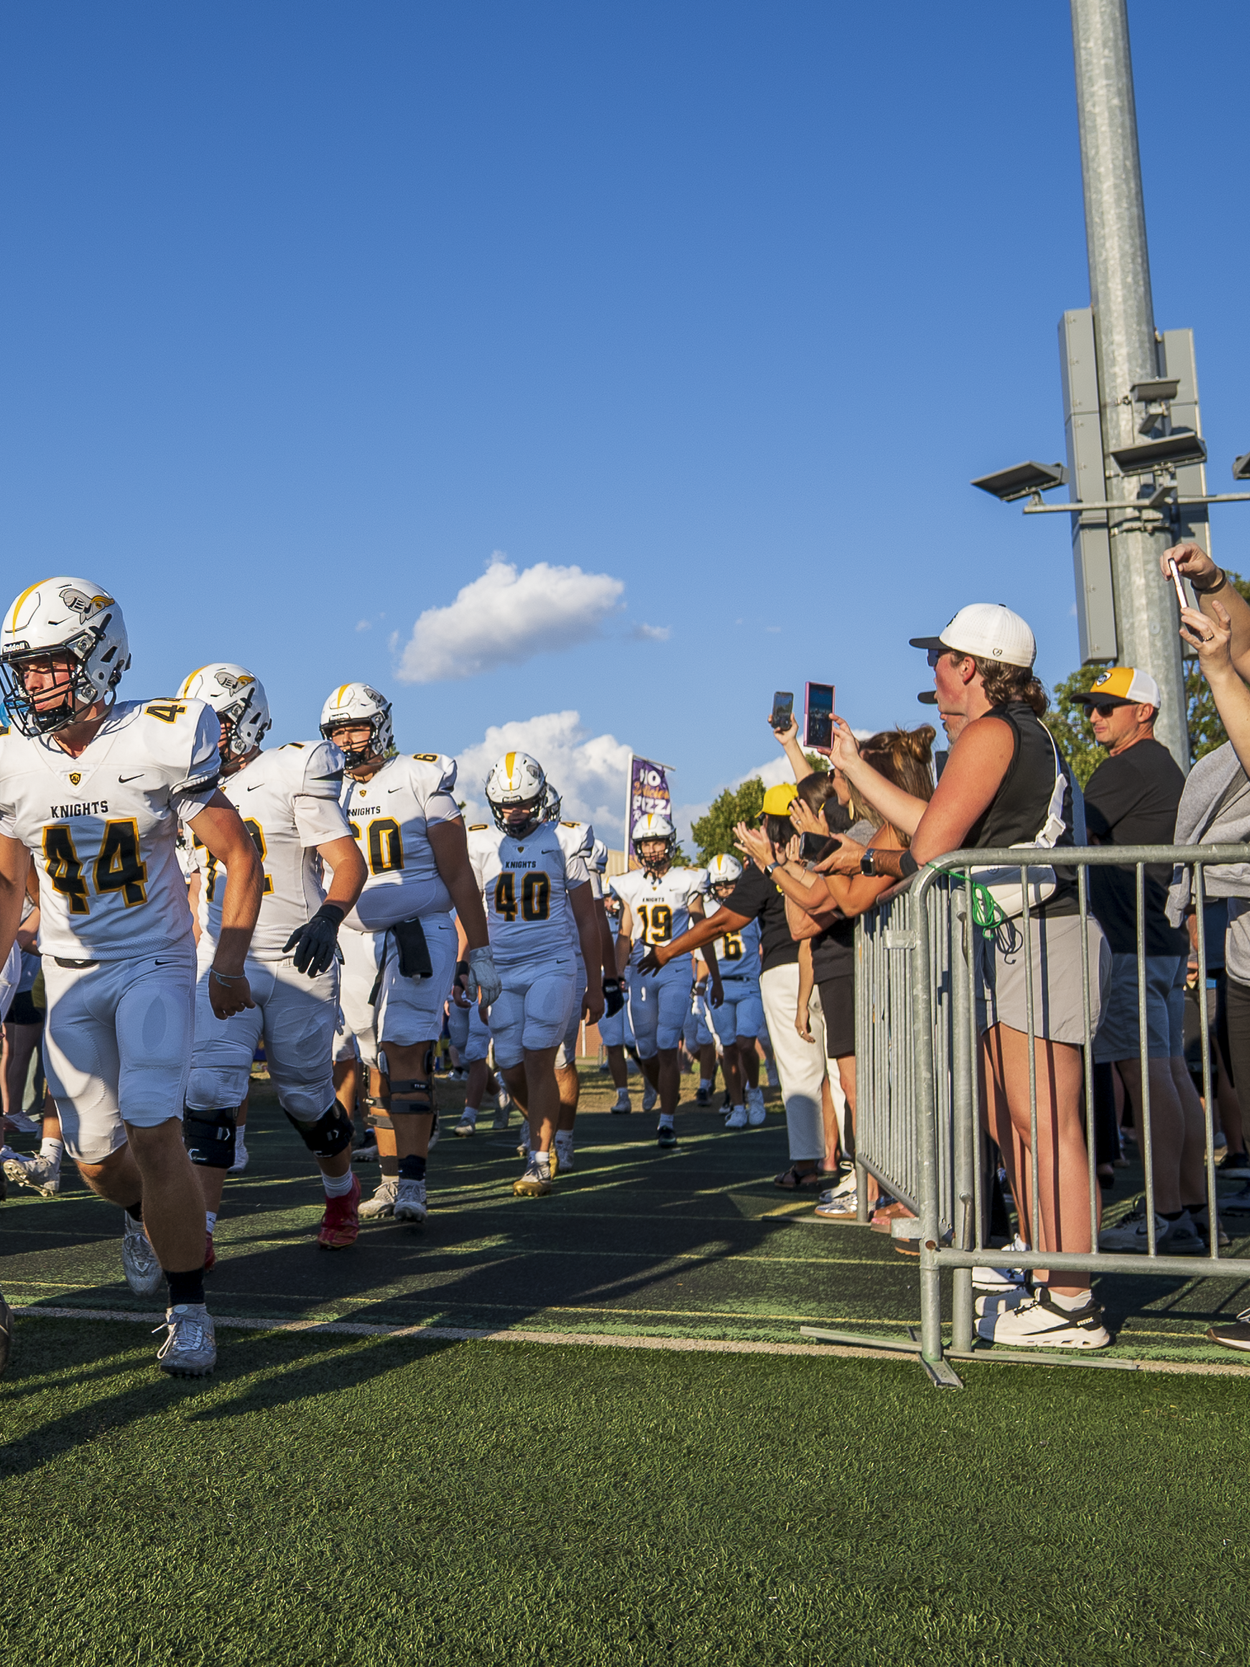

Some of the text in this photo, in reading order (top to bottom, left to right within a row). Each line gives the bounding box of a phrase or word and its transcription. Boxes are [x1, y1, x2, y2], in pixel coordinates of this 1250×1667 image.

[50, 801, 109, 818] KNIGHTS
[42, 817, 148, 915] 44
[494, 871, 551, 922] 40
[637, 904, 673, 944] 19
